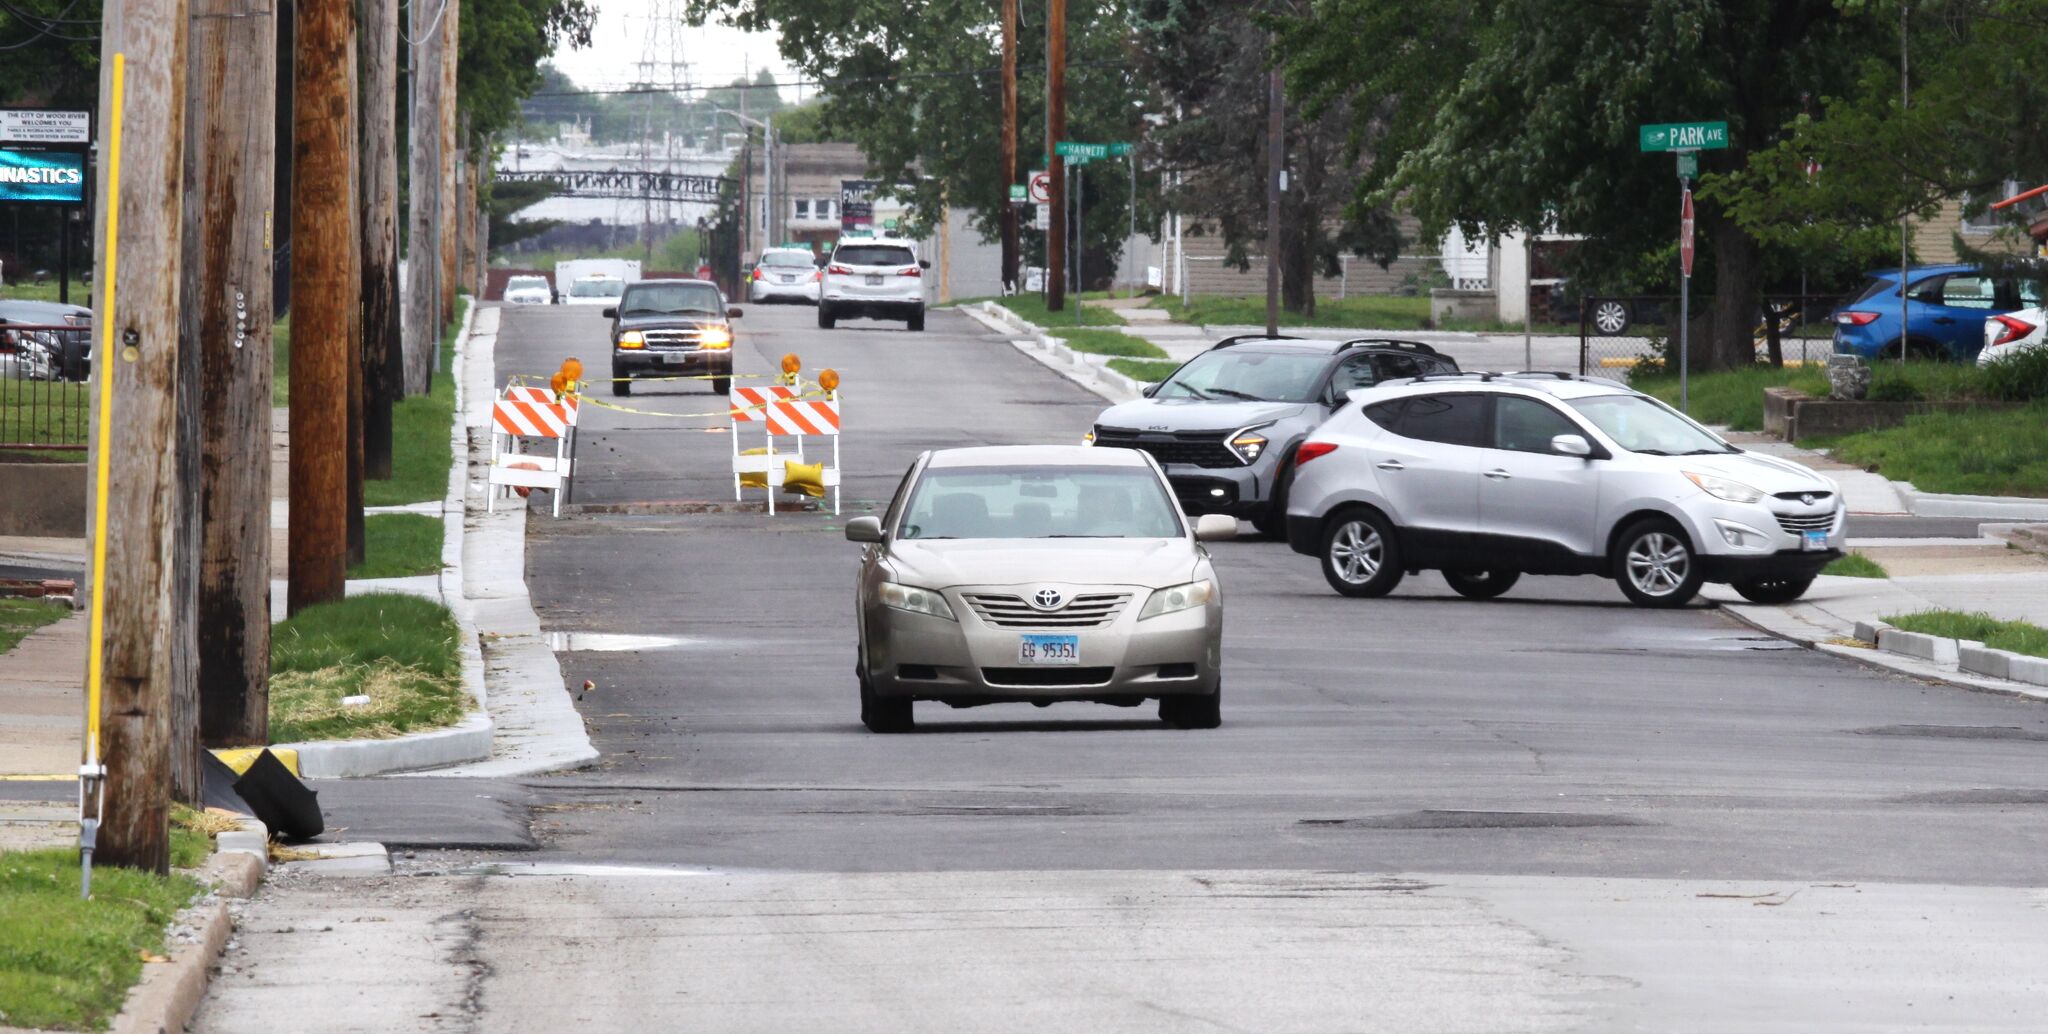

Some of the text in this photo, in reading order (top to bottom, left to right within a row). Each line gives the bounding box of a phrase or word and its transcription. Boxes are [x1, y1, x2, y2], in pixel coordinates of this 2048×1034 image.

[1670, 126, 1723, 146] PARK AVE
[1068, 143, 1105, 158] HARNETT
[0, 167, 79, 183] NASTICS
[1022, 642, 1076, 659] EG 95351
